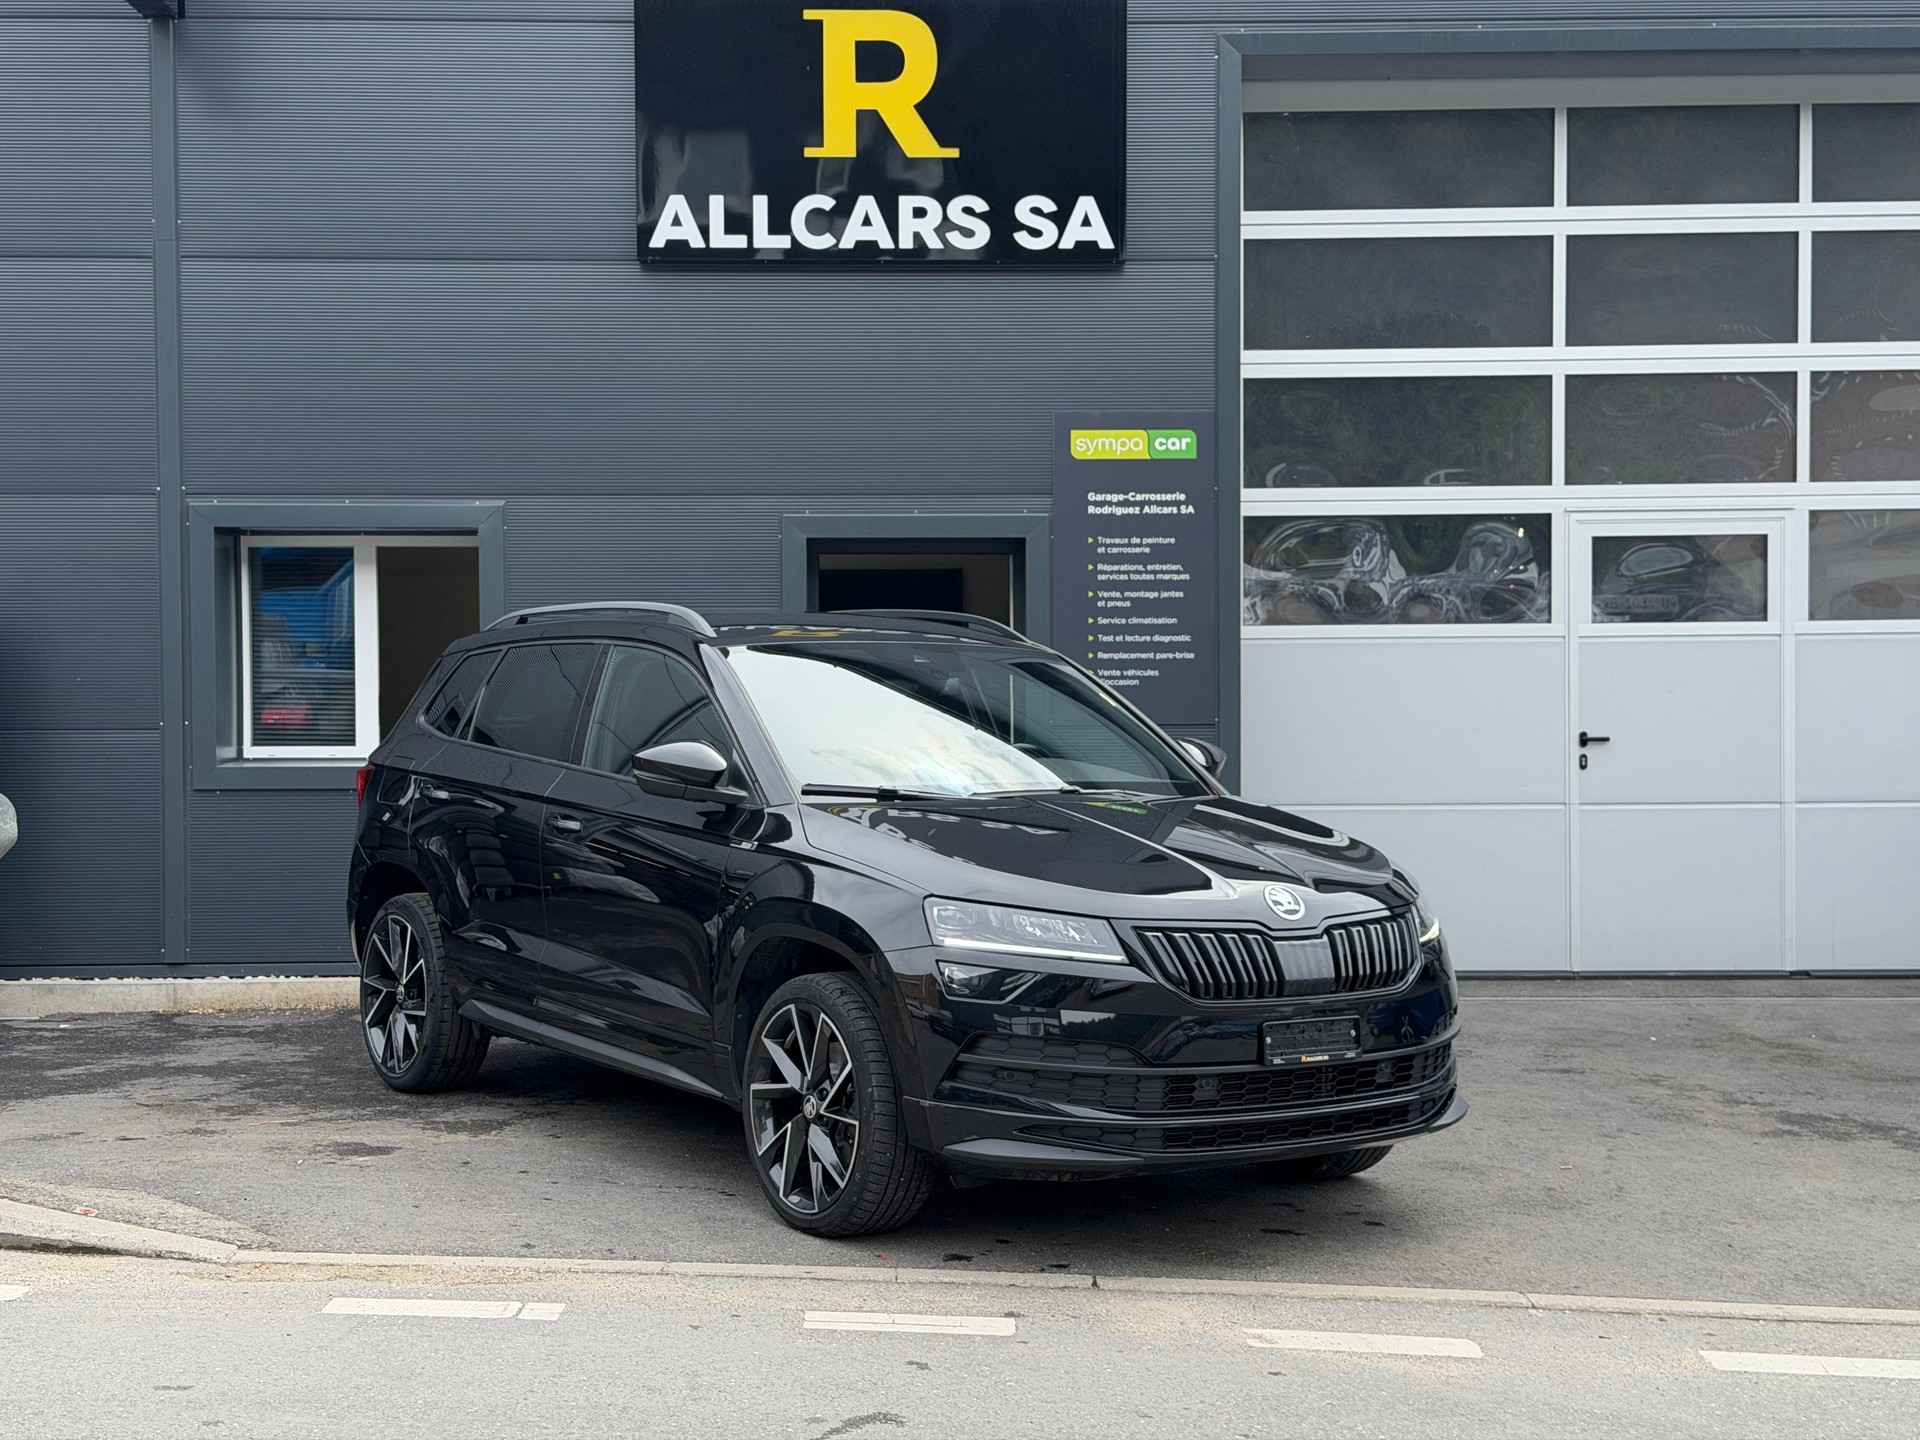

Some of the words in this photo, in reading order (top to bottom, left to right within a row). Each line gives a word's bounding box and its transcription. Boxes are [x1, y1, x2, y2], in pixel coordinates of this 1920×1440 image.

[803, 9, 960, 158] R
[648, 194, 991, 250] ALLCARS
[1012, 194, 1115, 250] SA
[1076, 437, 1143, 455] sympa
[1154, 437, 1191, 451] car
[1088, 492, 1186, 502] Garage-Carrosserie
[1088, 505, 1140, 515] Rodriguez
[1143, 505, 1178, 514] Allcars
[1180, 505, 1195, 514] SA
[1143, 537, 1175, 546] peinture
[1097, 563, 1145, 572] Réparations,
[1147, 564, 1183, 572] entretien,
[1157, 574, 1190, 582] marques
[1097, 591, 1123, 599] Vente,
[1124, 591, 1159, 599] montage
[1160, 591, 1184, 599] jantes
[1097, 617, 1126, 625] Service
[1128, 617, 1178, 625] climatisation
[1152, 634, 1191, 643] diagnostic
[1097, 652, 1154, 660] Remplacement
[1156, 652, 1195, 660] pare-brise
